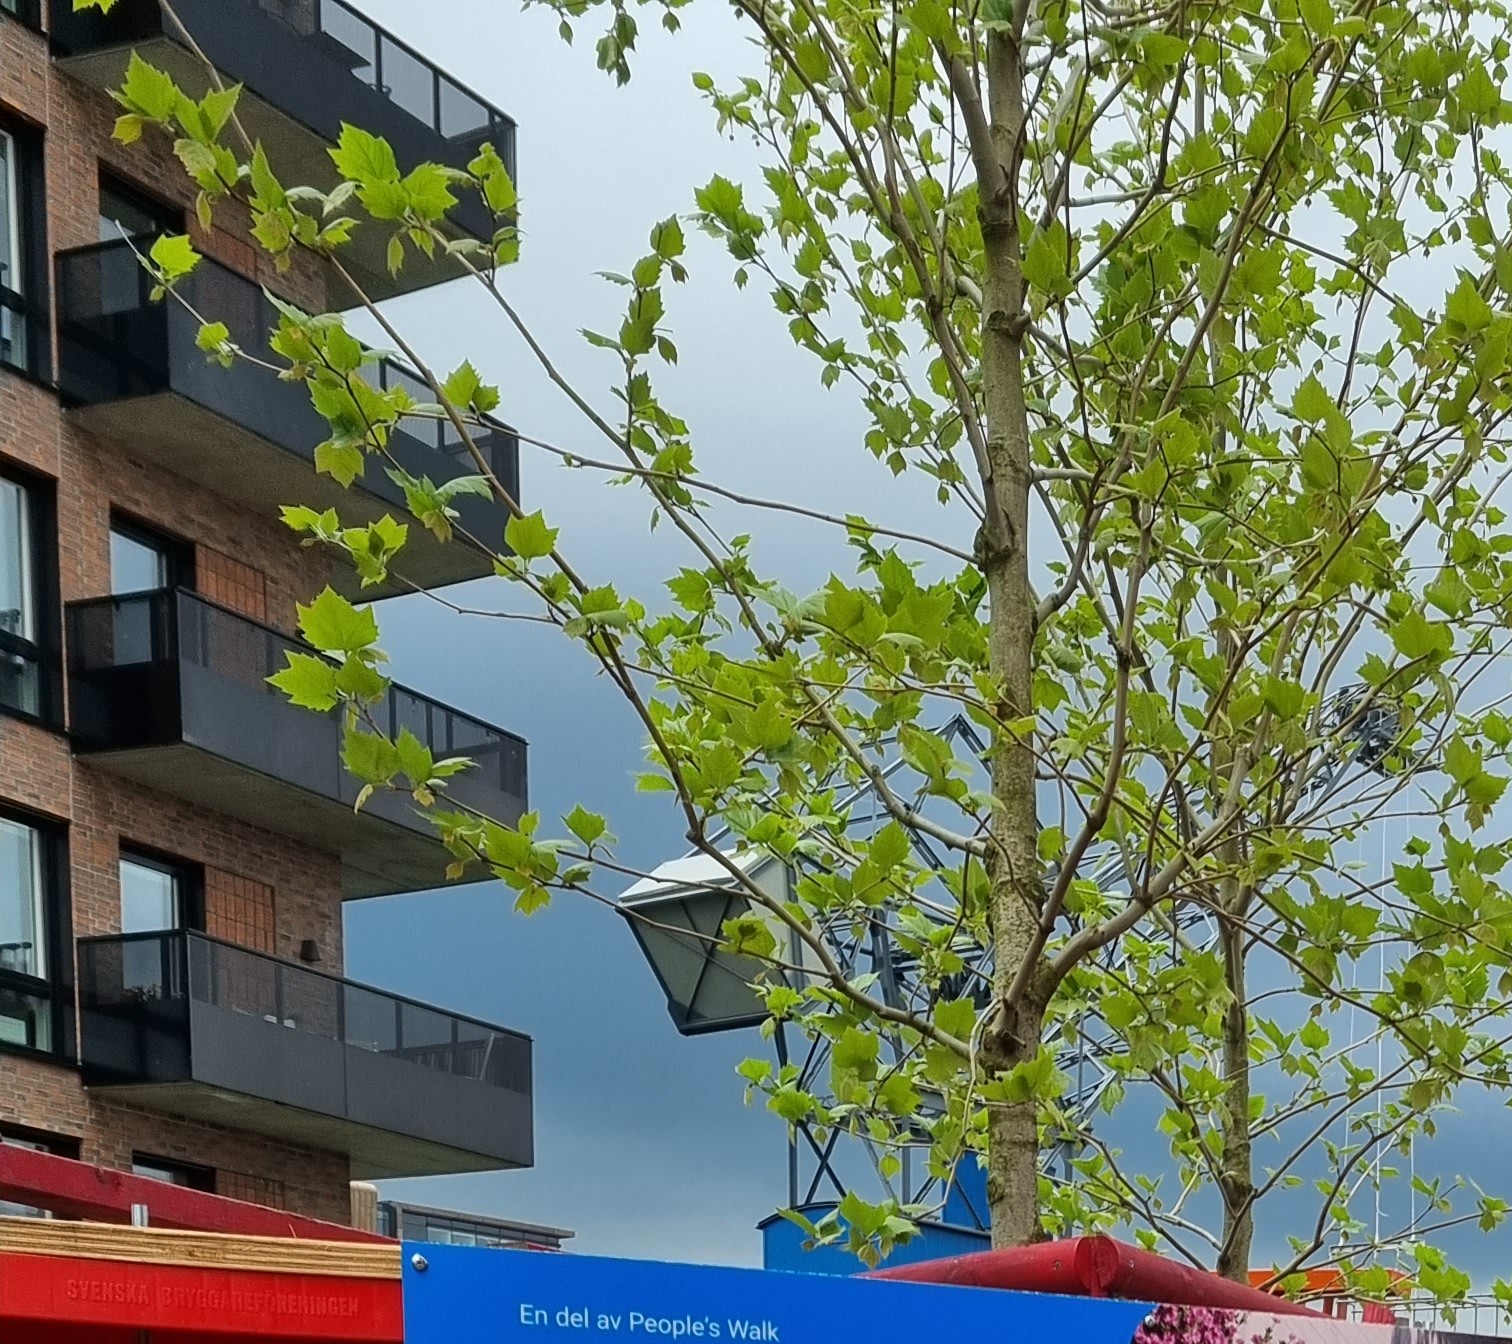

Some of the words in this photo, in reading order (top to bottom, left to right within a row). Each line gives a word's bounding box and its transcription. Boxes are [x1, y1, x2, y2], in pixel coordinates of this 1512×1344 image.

[520, 1303, 548, 1326] En
[555, 1306, 589, 1329] del
[596, 1314, 622, 1330] av
[727, 1319, 780, 1342] Walk
